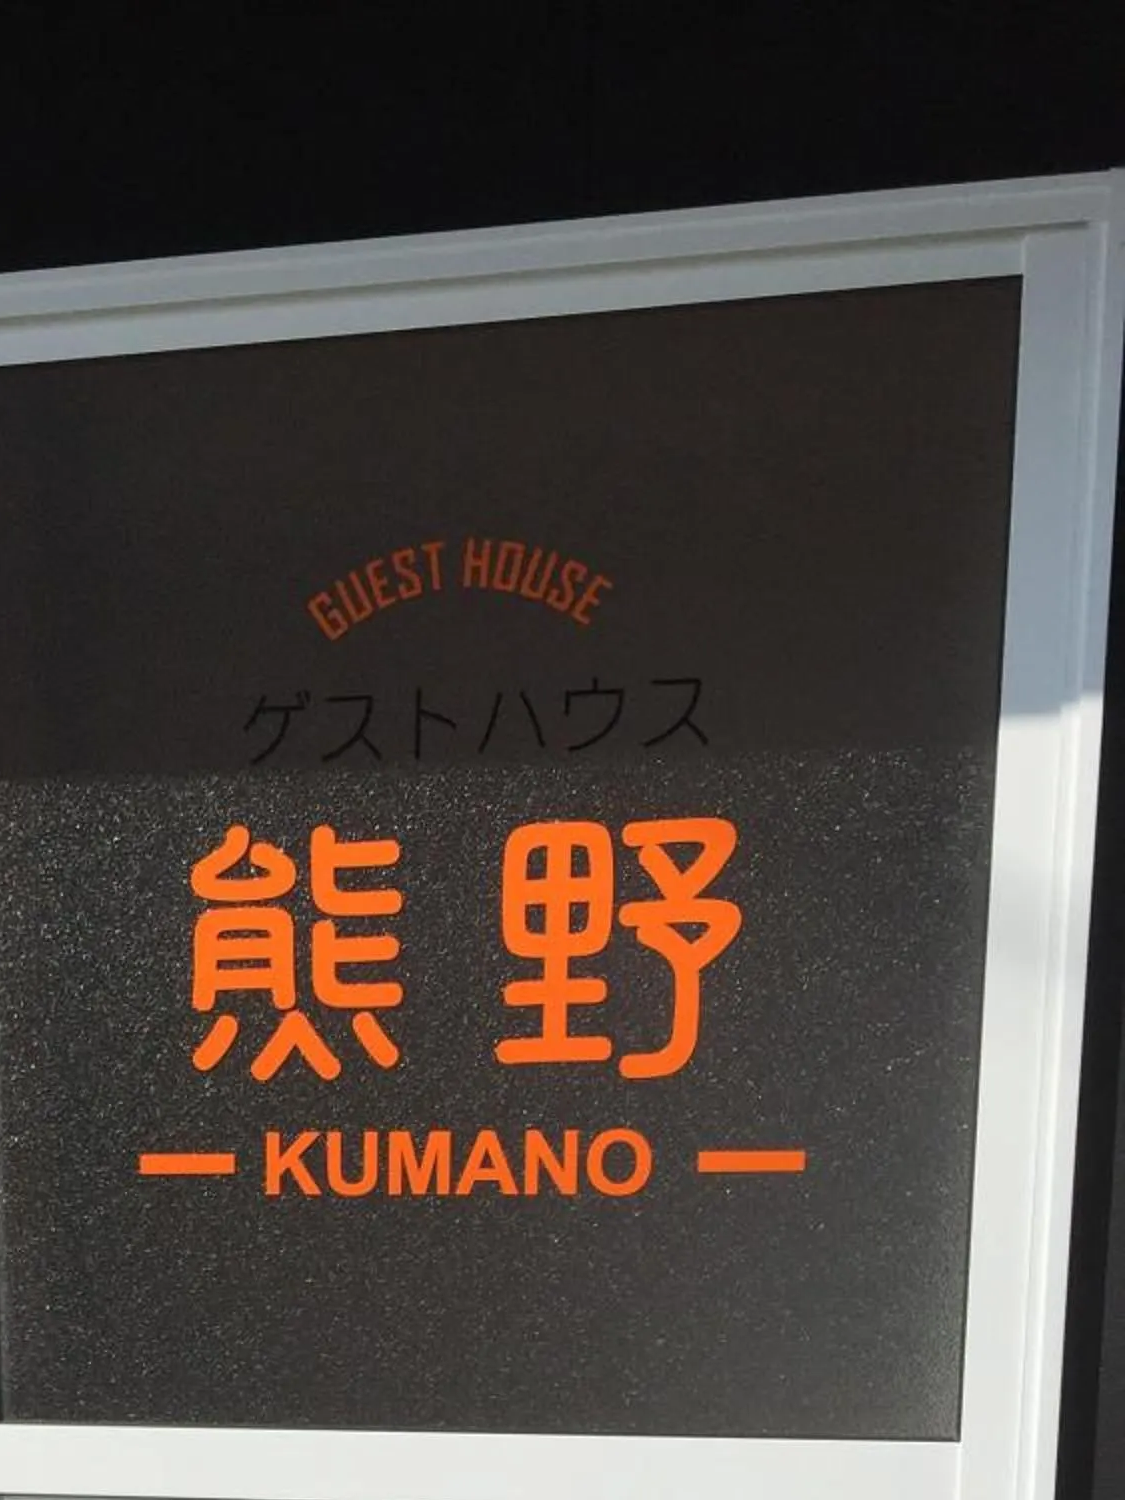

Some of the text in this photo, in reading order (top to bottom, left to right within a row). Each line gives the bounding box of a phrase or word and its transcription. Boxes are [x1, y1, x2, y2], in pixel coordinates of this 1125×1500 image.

[307, 537, 614, 641] GUEST HOUSE
[243, 677, 709, 765] ゲストハウス
[189, 816, 743, 1082] 熊野
[263, 1127, 653, 1197] KUMANO
